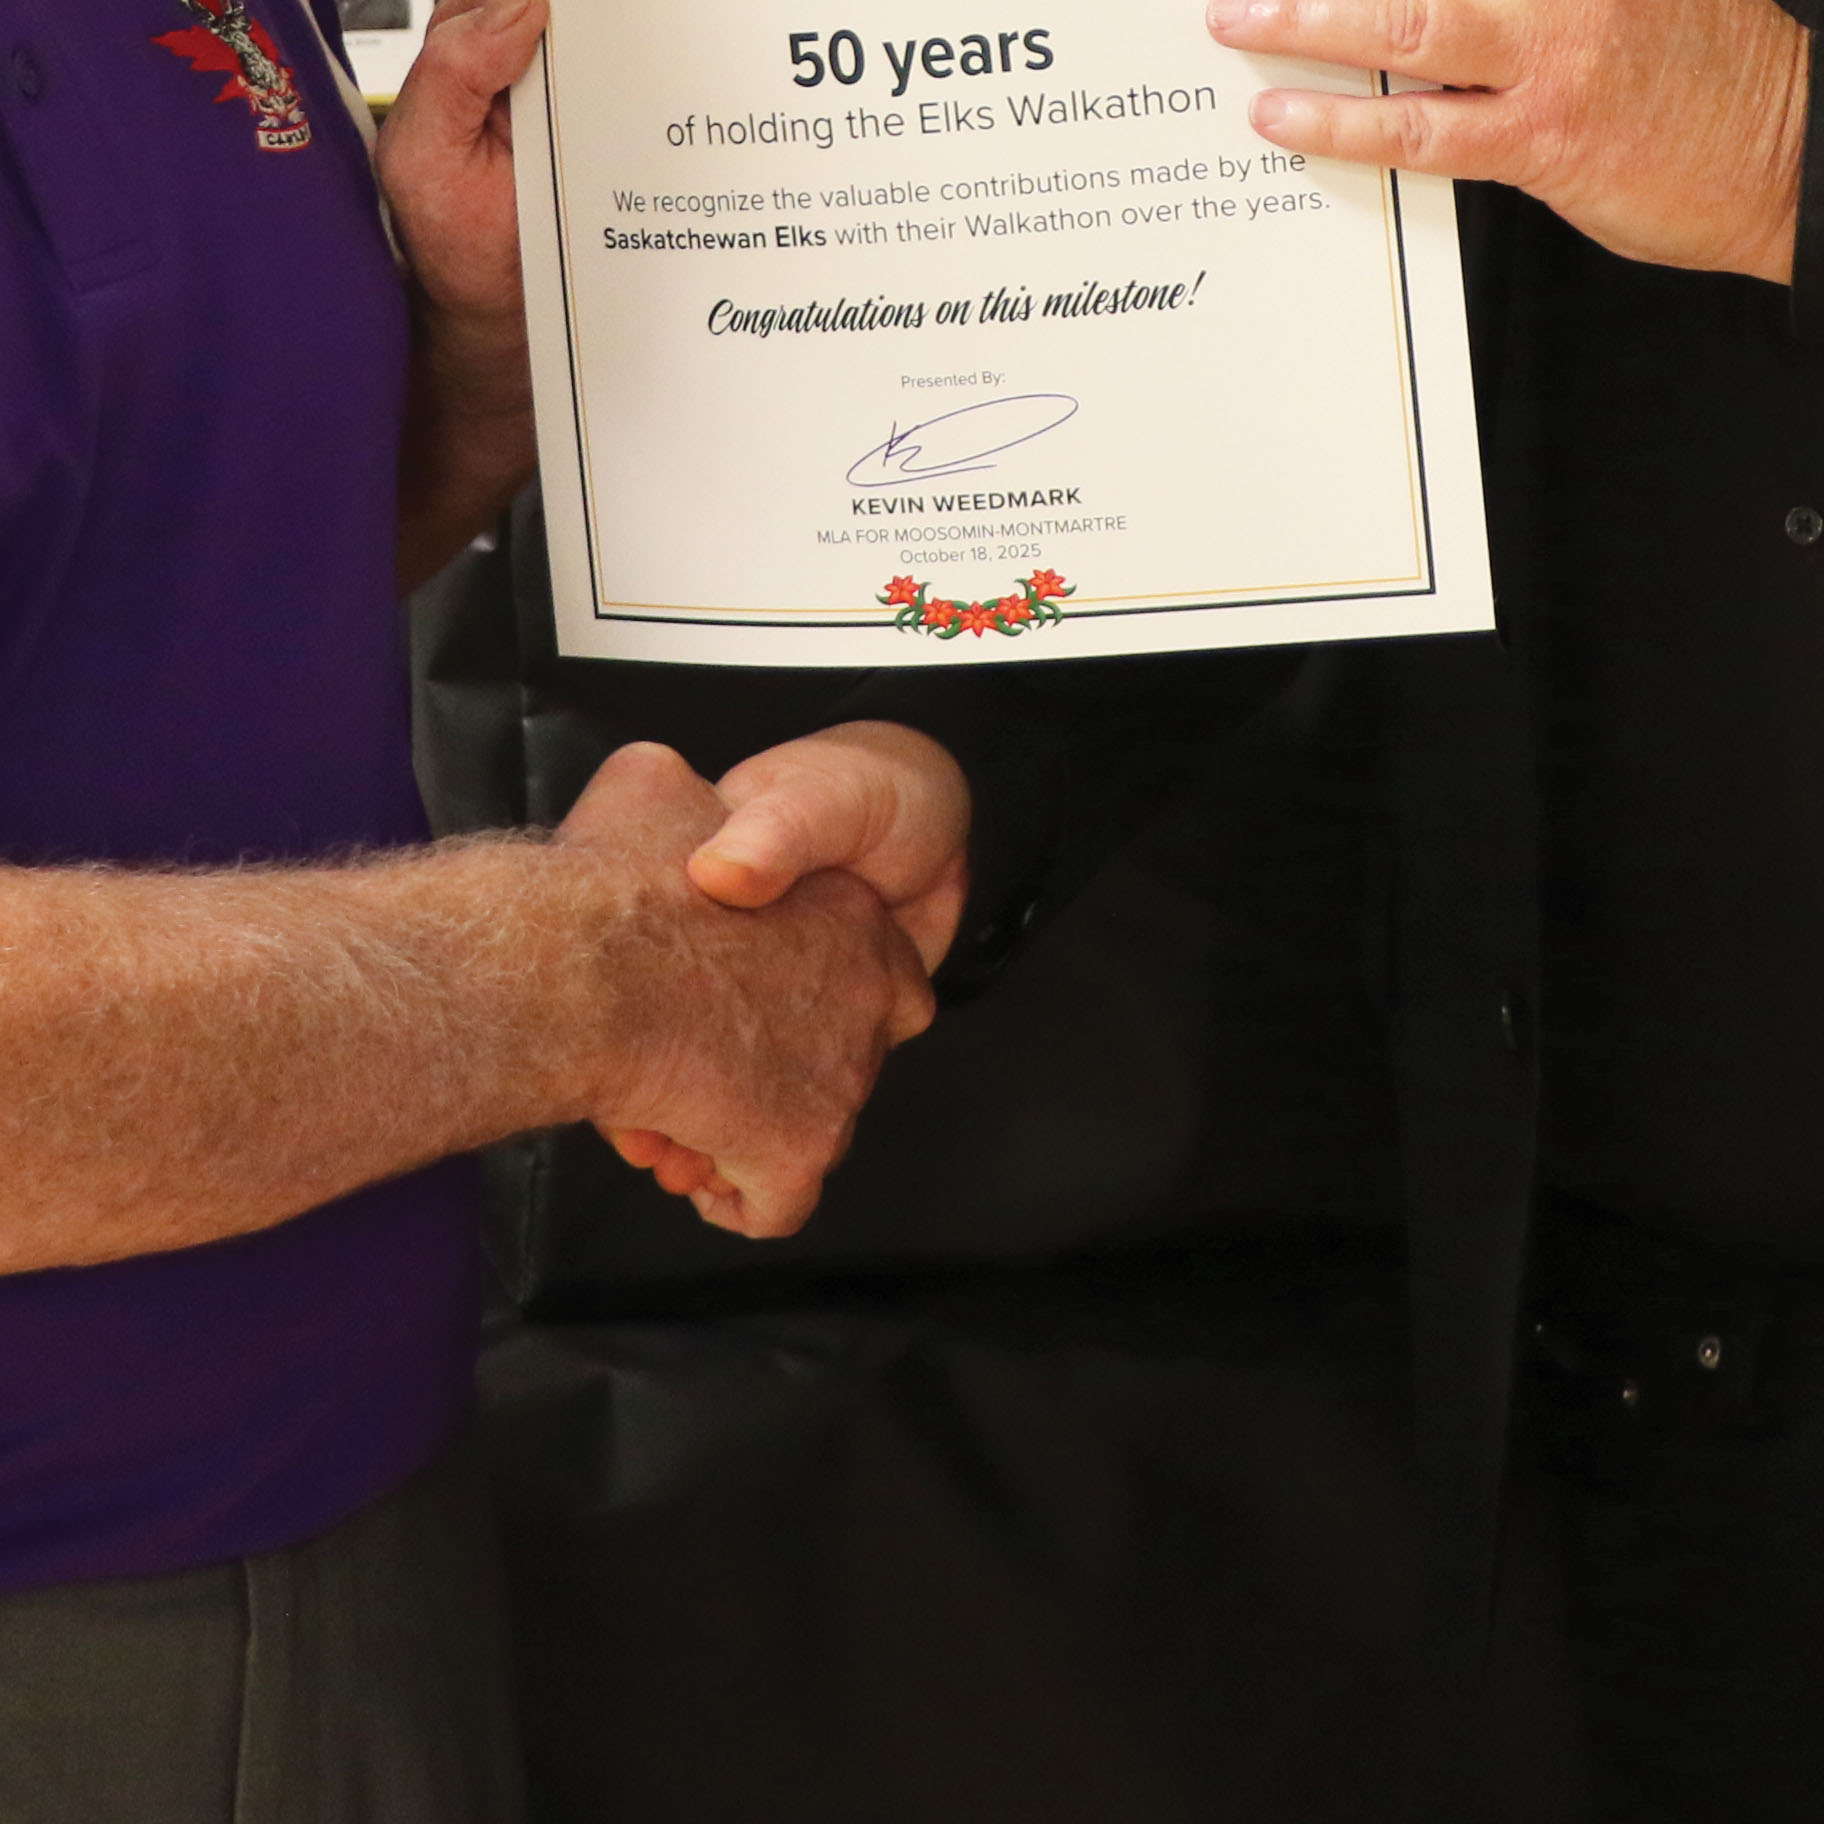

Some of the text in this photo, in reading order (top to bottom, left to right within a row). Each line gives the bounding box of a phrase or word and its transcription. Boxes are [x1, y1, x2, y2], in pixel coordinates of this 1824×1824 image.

[787, 27, 1054, 98] 50 years
[665, 83, 1216, 150] of holding the Elks Walkathon
[611, 150, 1307, 218] We recognize the valuable contributions made by the
[602, 191, 1330, 251] Saskatchewan Elks with their Walkathon over the years.
[706, 269, 1207, 339] Congratulations on this milestone!
[900, 369, 1007, 389] Presented By:
[816, 514, 1126, 544] MLA FOR MOOSOMIN-MONTMARTRE
[851, 486, 1082, 516] KEVIN WEEDMARK
[899, 542, 1042, 564] October 18, 2025
